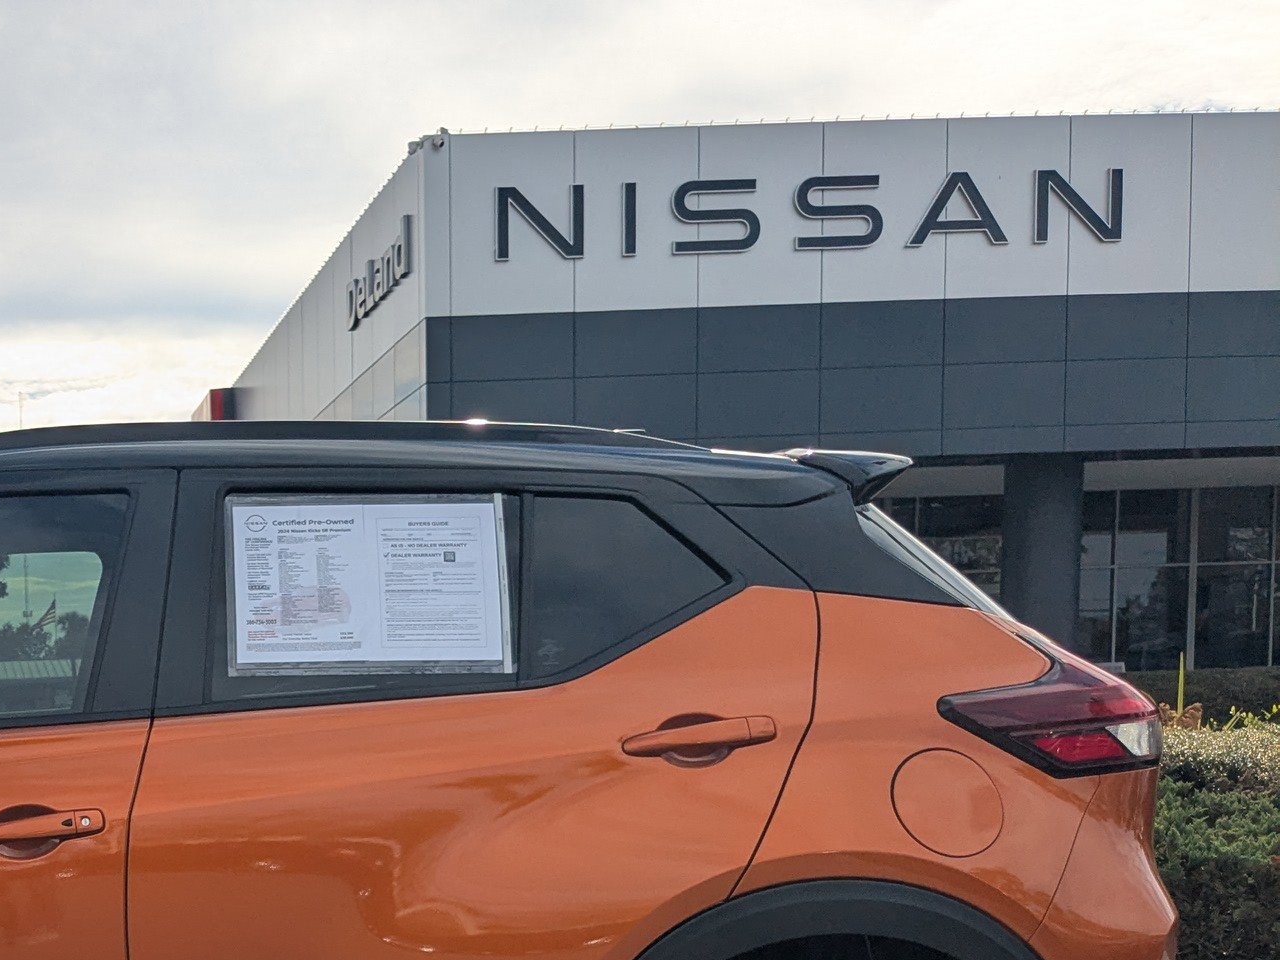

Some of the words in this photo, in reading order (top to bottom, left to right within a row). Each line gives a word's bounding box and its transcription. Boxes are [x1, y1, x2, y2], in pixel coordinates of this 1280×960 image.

[494, 168, 1124, 261] NISSAN
[272, 519, 307, 527] Certified
[308, 518, 355, 526] Pre-Owned
